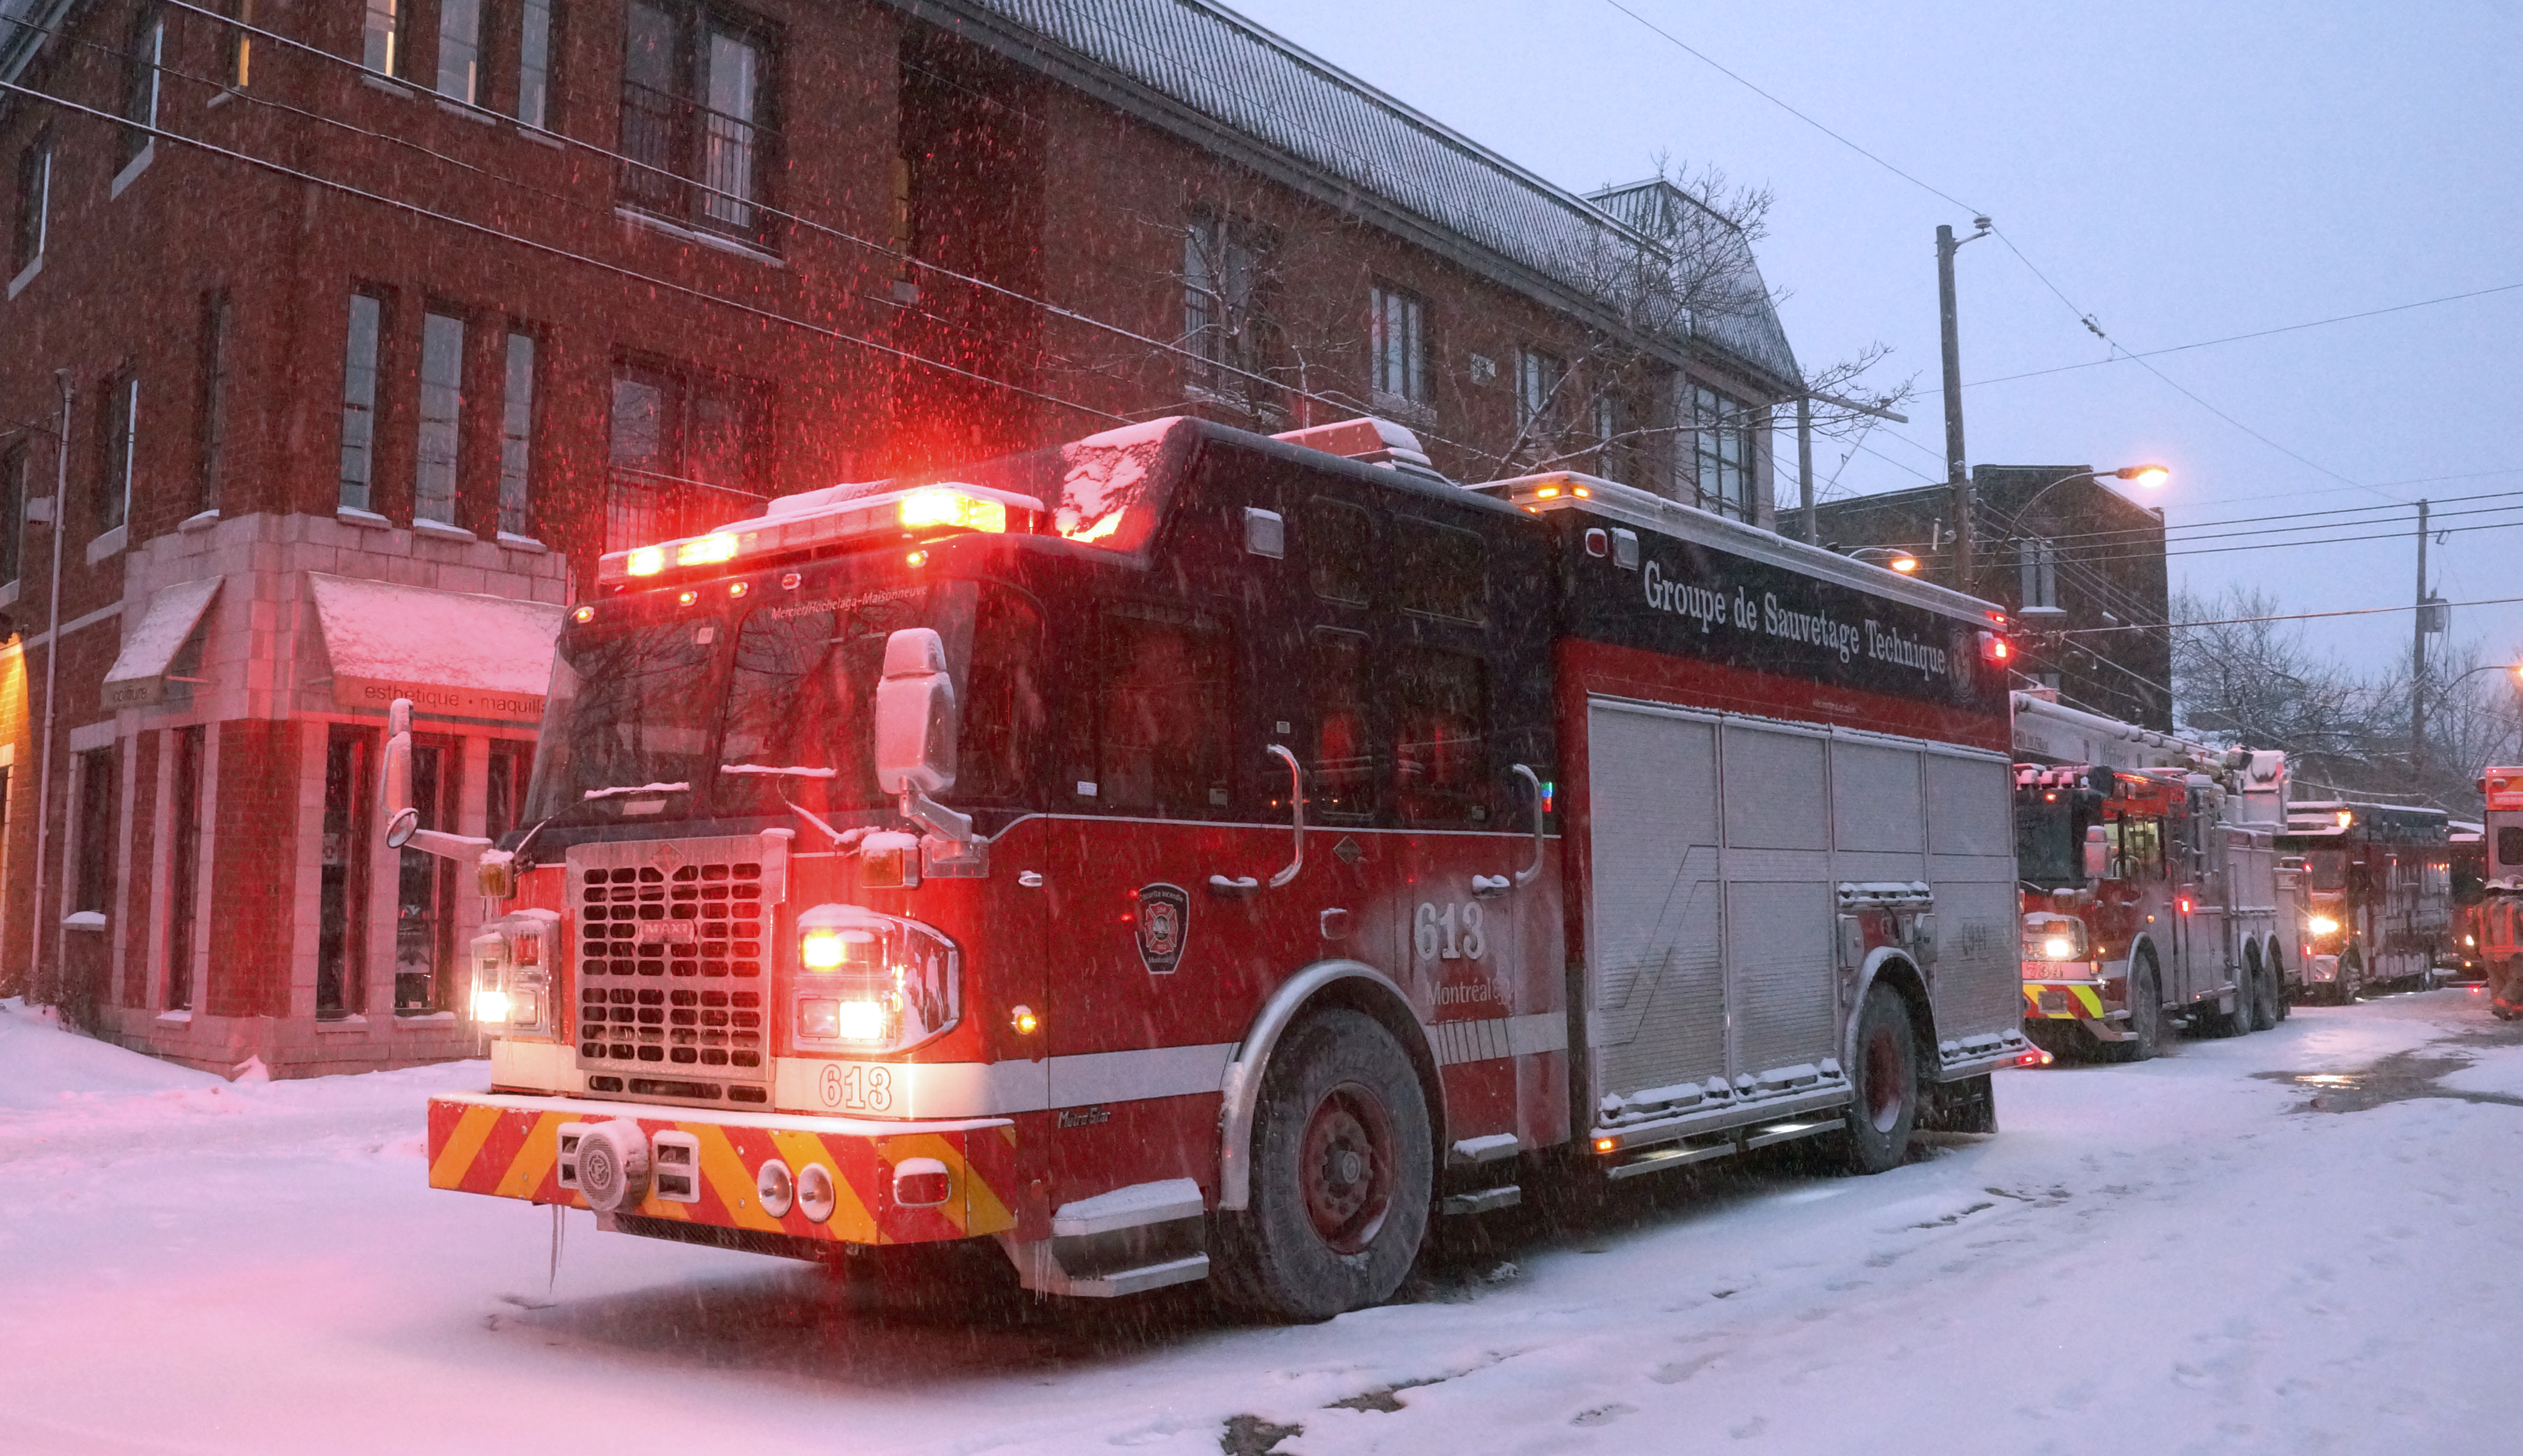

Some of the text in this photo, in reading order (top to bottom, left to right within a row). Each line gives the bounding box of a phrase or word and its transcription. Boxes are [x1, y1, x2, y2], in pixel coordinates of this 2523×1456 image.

[1644, 560, 1946, 681] Groupe de Sauvetage Technique
[365, 685, 459, 708] esthétique
[1414, 901, 1484, 961] 613
[2026, 963, 2063, 978] 734
[1429, 977, 1492, 1006] Montréal
[819, 1064, 892, 1112] 613
